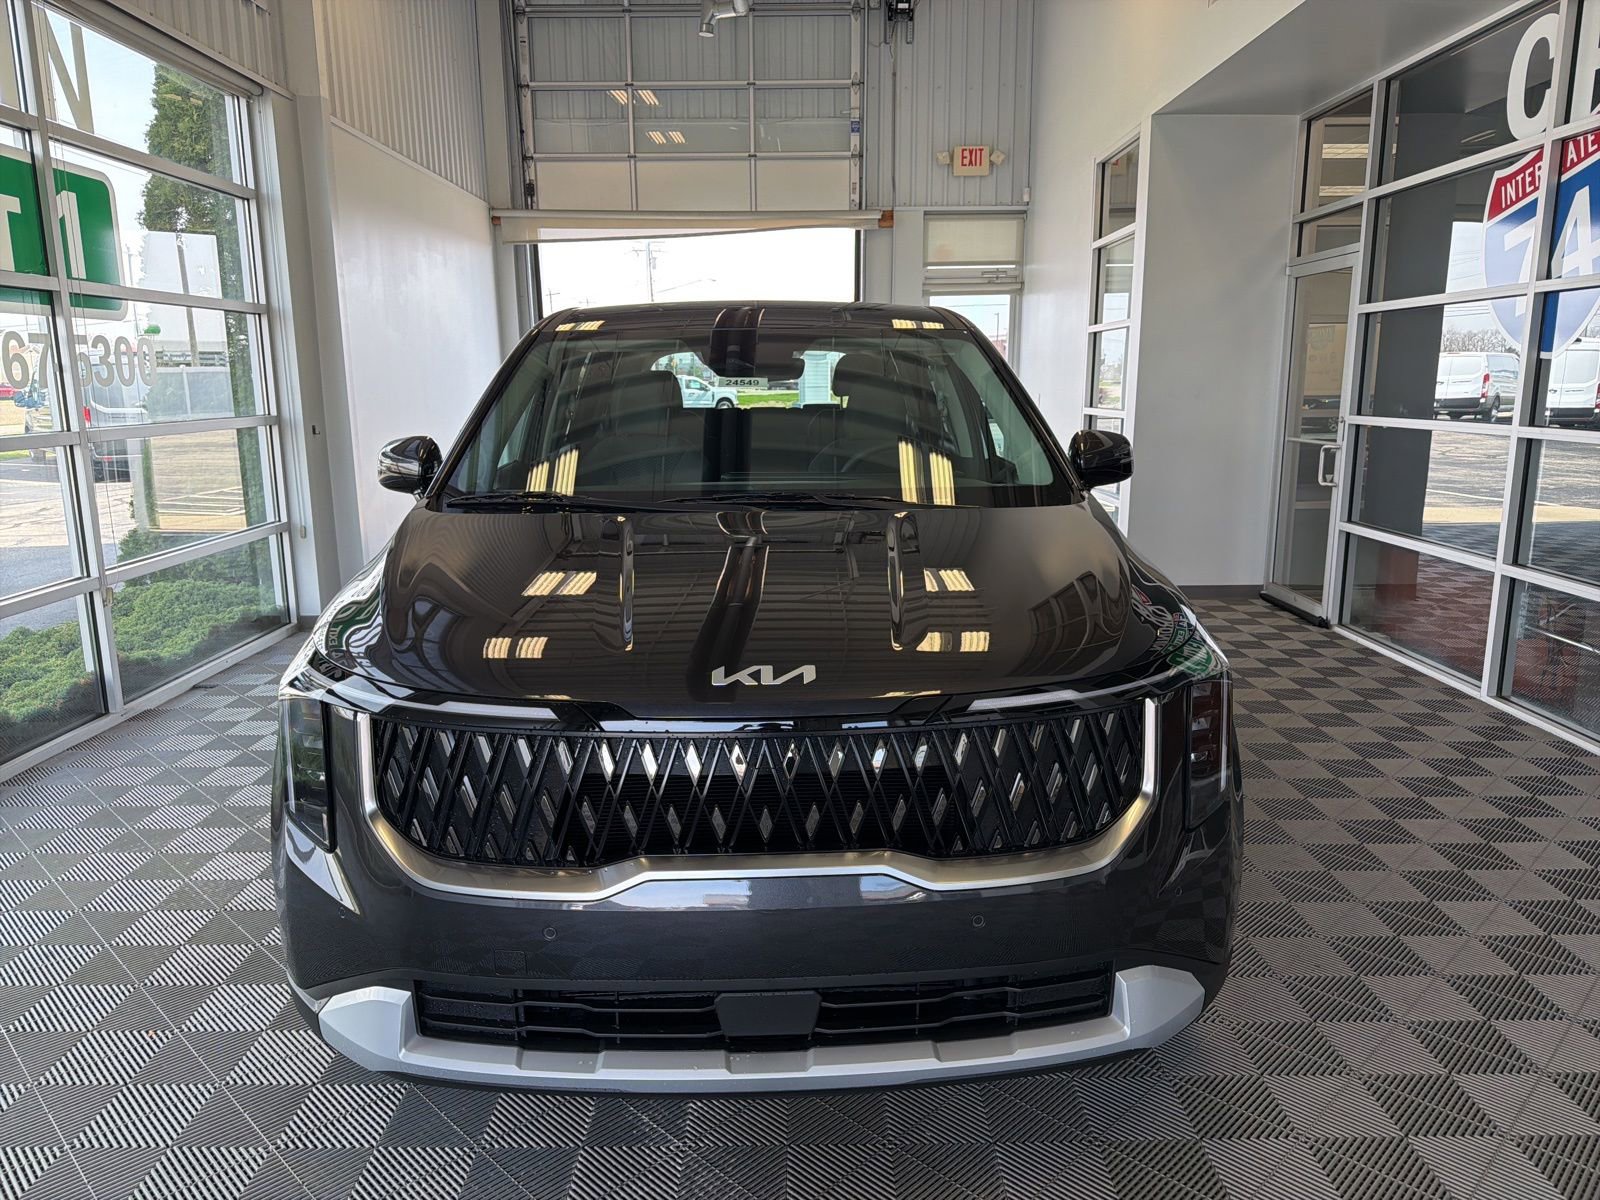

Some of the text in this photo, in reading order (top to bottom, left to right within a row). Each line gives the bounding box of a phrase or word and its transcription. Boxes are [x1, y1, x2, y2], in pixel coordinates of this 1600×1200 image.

[960, 147, 985, 167] EXIT
[1501, 133, 1598, 209] INTERATE
[56, 190, 87, 280] 1
